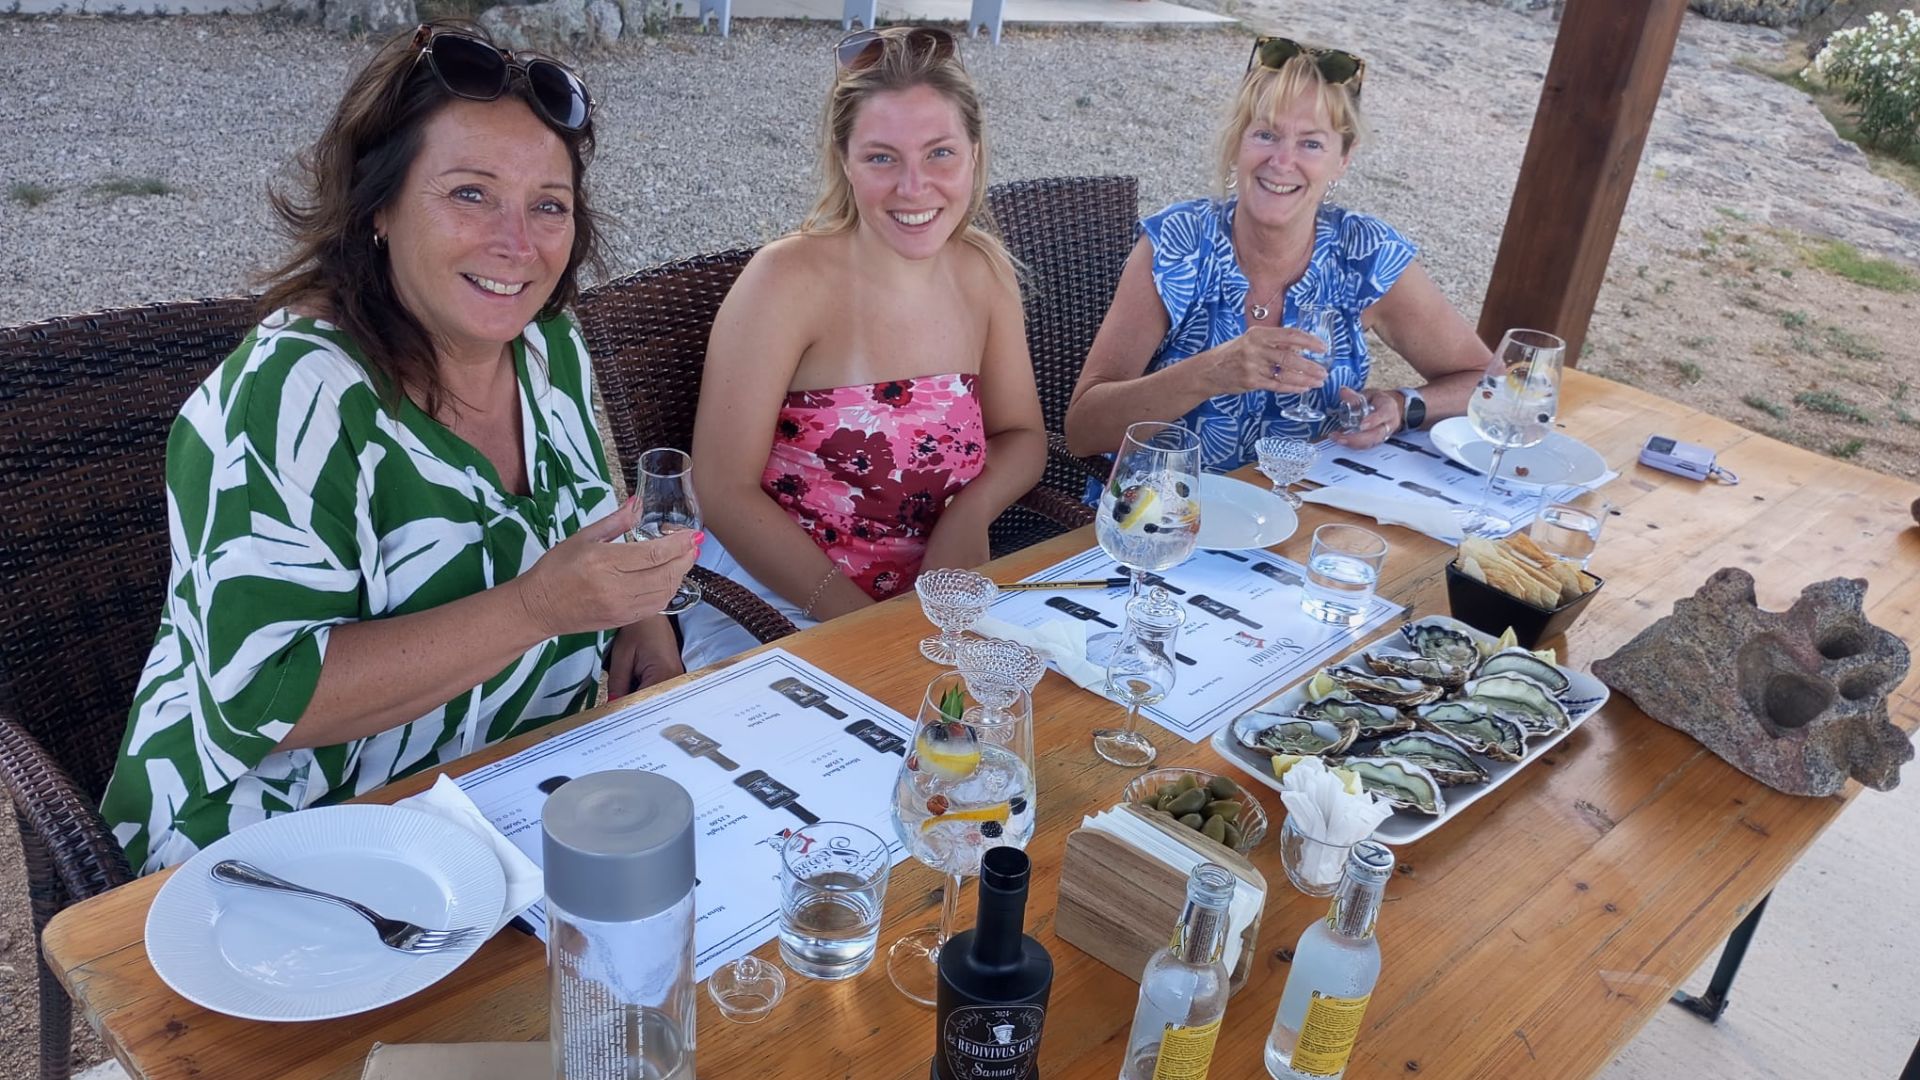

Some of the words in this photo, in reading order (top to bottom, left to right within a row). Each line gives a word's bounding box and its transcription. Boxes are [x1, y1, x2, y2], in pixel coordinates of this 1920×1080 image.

[957, 1038, 1016, 1060] REDIVIVUS
[1018, 1038, 1034, 1054] GIN
[971, 1061, 1018, 1078] Sannai
